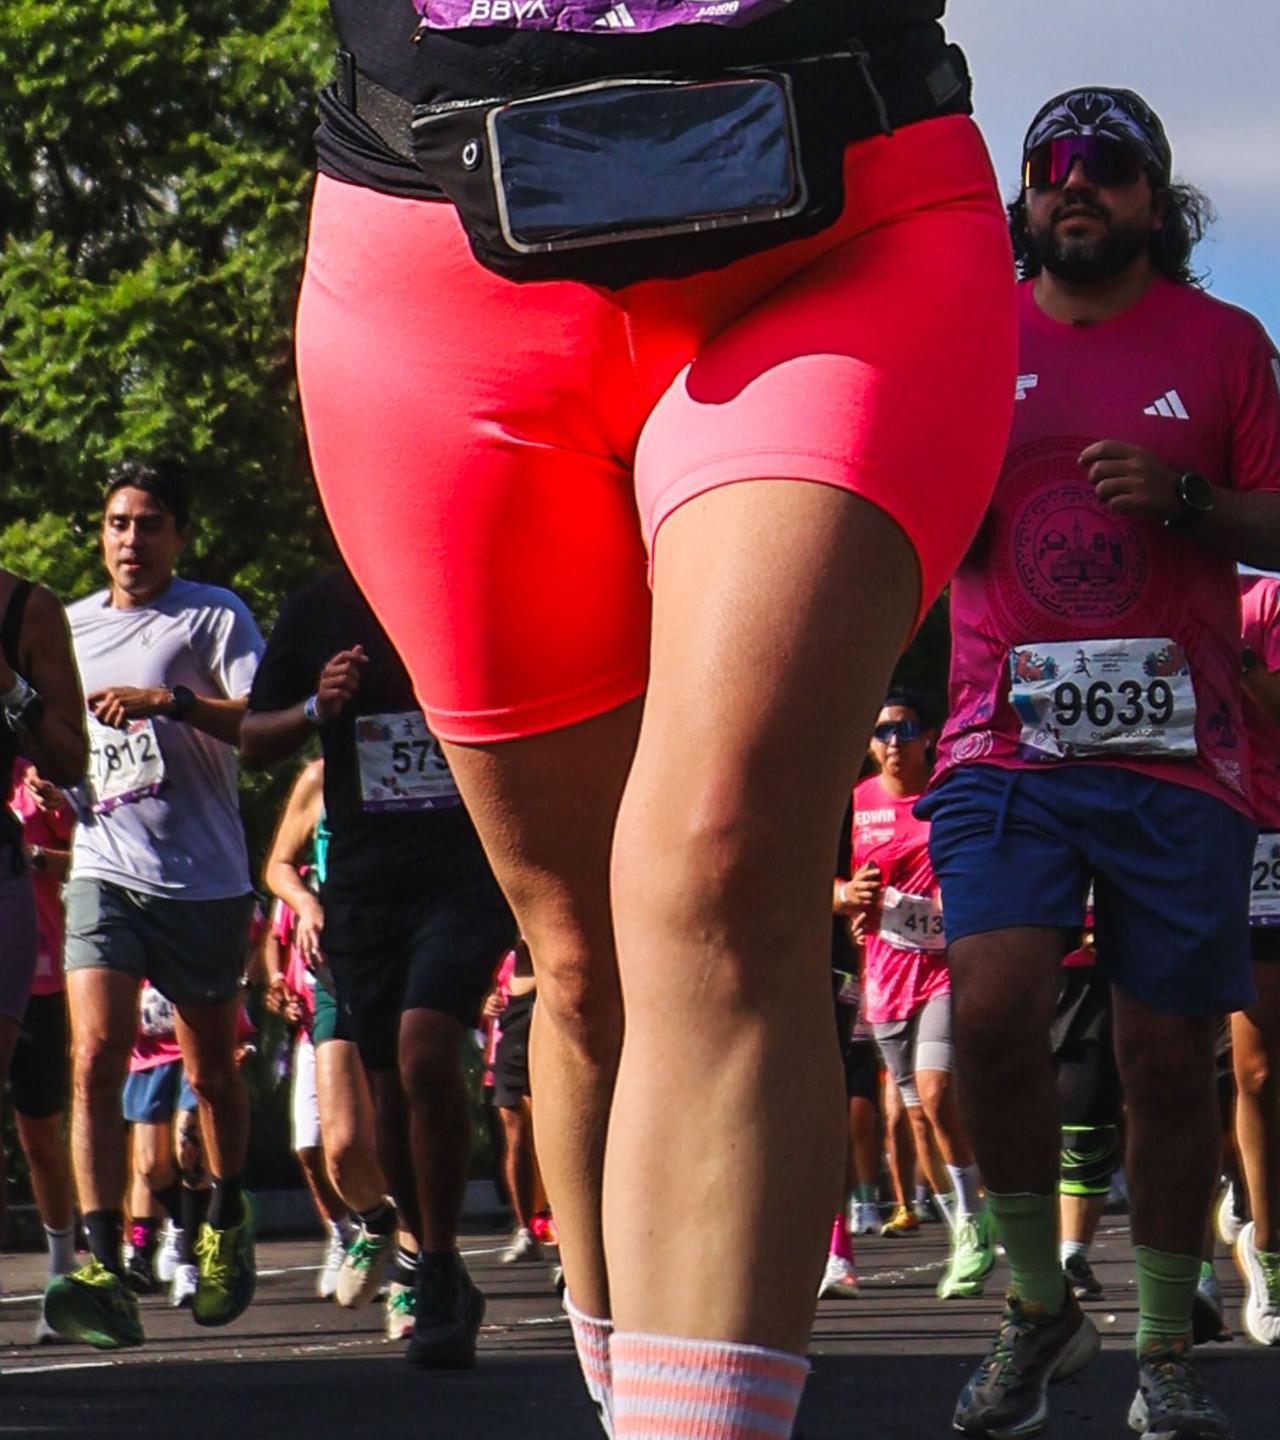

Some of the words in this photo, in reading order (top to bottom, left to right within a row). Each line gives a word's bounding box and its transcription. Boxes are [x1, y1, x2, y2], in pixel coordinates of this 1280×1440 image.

[469, 0, 550, 21] BBVA
[1054, 679, 1175, 727] 9639
[855, 808, 897, 825] EDWIN
